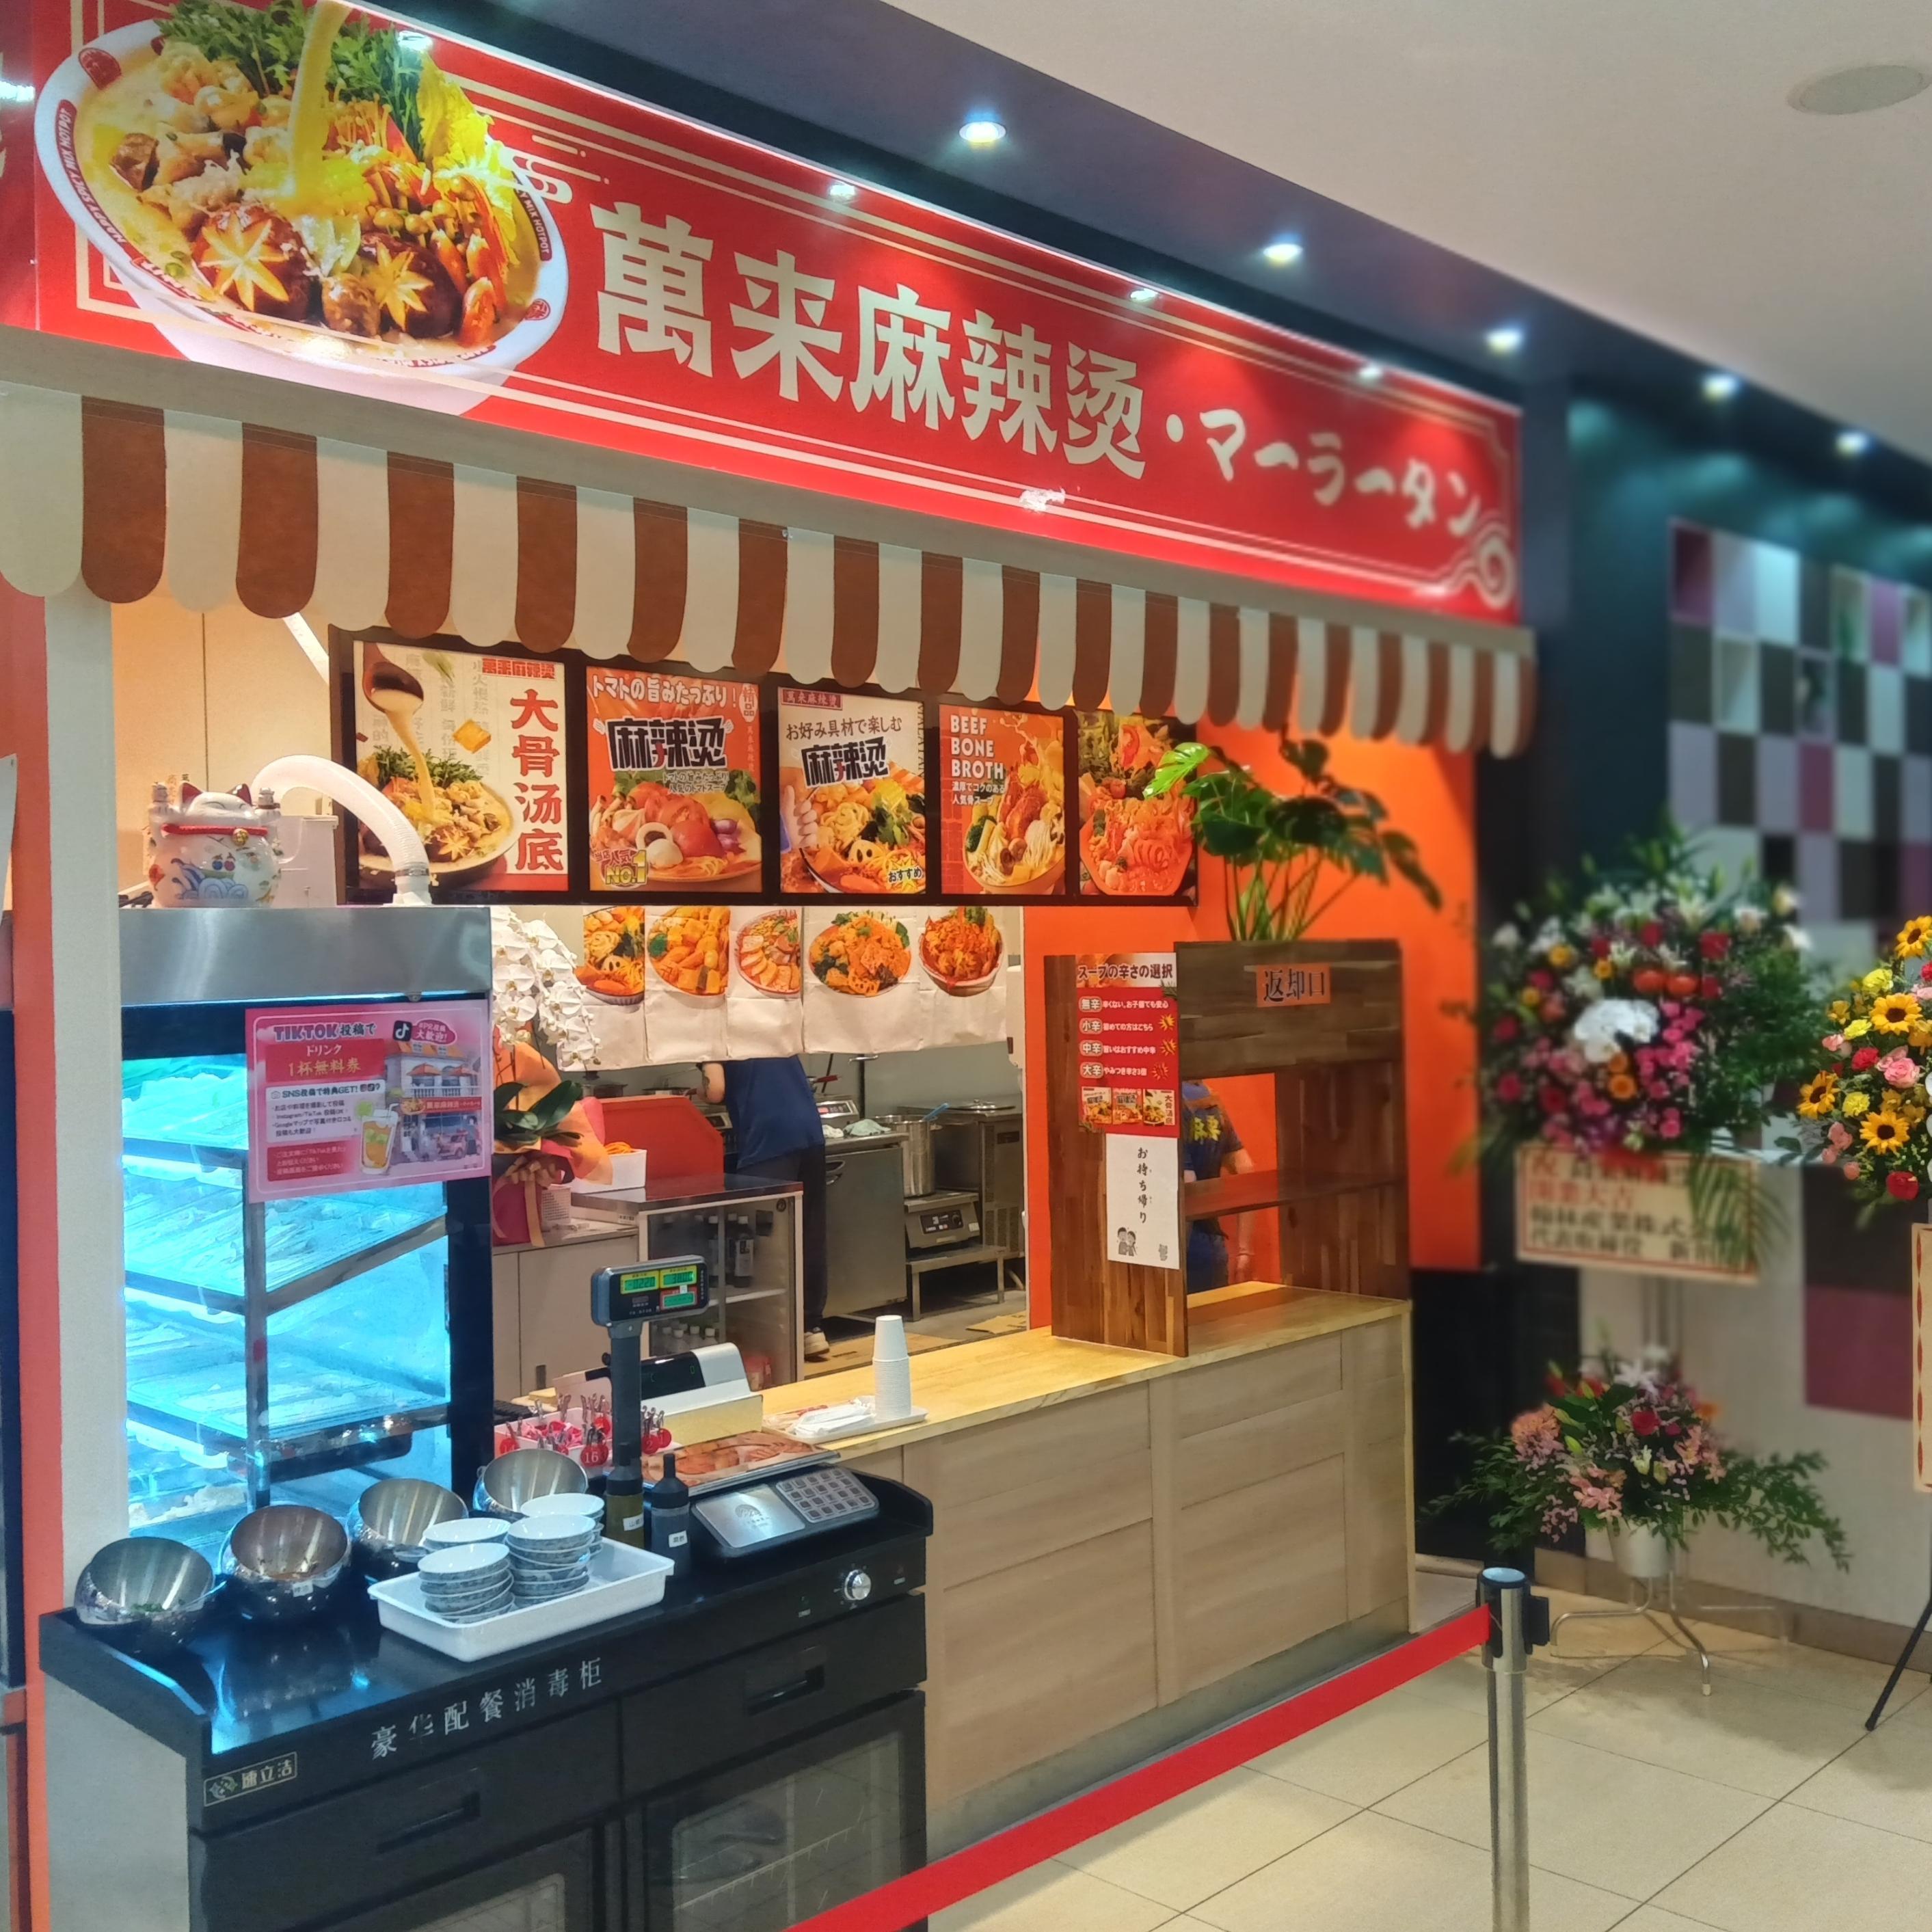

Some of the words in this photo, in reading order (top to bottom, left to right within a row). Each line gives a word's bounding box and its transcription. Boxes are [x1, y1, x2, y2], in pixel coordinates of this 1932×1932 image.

[533, 217, 550, 255] HOTPOT
[786, 716, 902, 740] お好み具材で楽しむ
[950, 714, 987, 736] BEEF
[608, 718, 727, 768] 麻辣烫
[951, 737, 995, 757] BONE
[801, 736, 889, 786] 麻辣烫
[951, 759, 1004, 780] BROTH
[510, 688, 564, 872] 大骨汤底
[888, 867, 923, 883] おすすめ
[1078, 963, 1173, 980] スープの辛さの選択
[1263, 968, 1325, 1002] 返却口
[1082, 1021, 1101, 1032] 小辛
[306, 1045, 343, 1057] ドリンク
[1082, 1043, 1101, 1054] 中辛
[288, 1058, 362, 1077] 1杯無料券
[1082, 1064, 1102, 1076] 大辛
[1137, 1146, 1149, 1224] お持ち帰り
[585, 1453, 600, 1463] 16
[371, 1656, 602, 1760] 豪华配餐消毒柜
